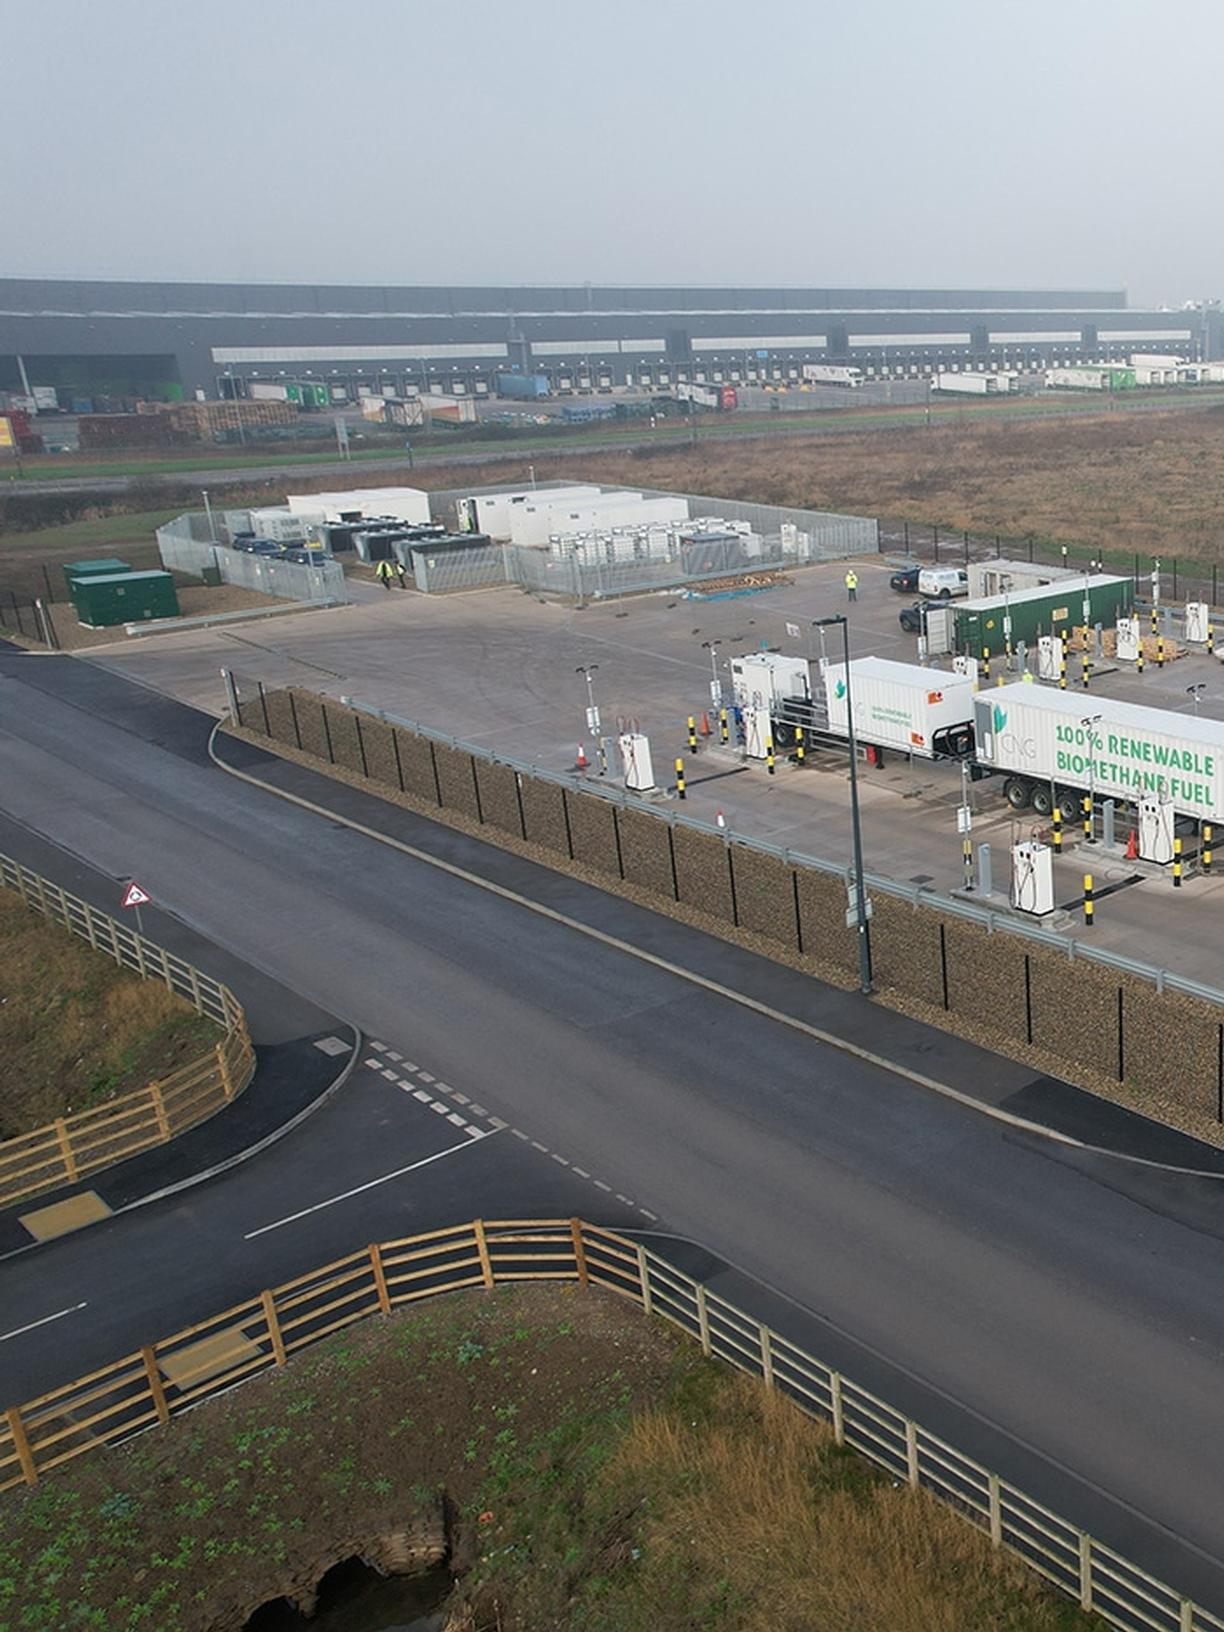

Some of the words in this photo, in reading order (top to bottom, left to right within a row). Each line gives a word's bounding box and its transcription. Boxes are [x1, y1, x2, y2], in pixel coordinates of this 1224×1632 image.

[1056, 725, 1103, 751] 100%
[1108, 734, 1215, 777] RENEWABLE
[1056, 751, 1166, 795] BIOMETHANE
[1170, 778, 1215, 807] FUEL
